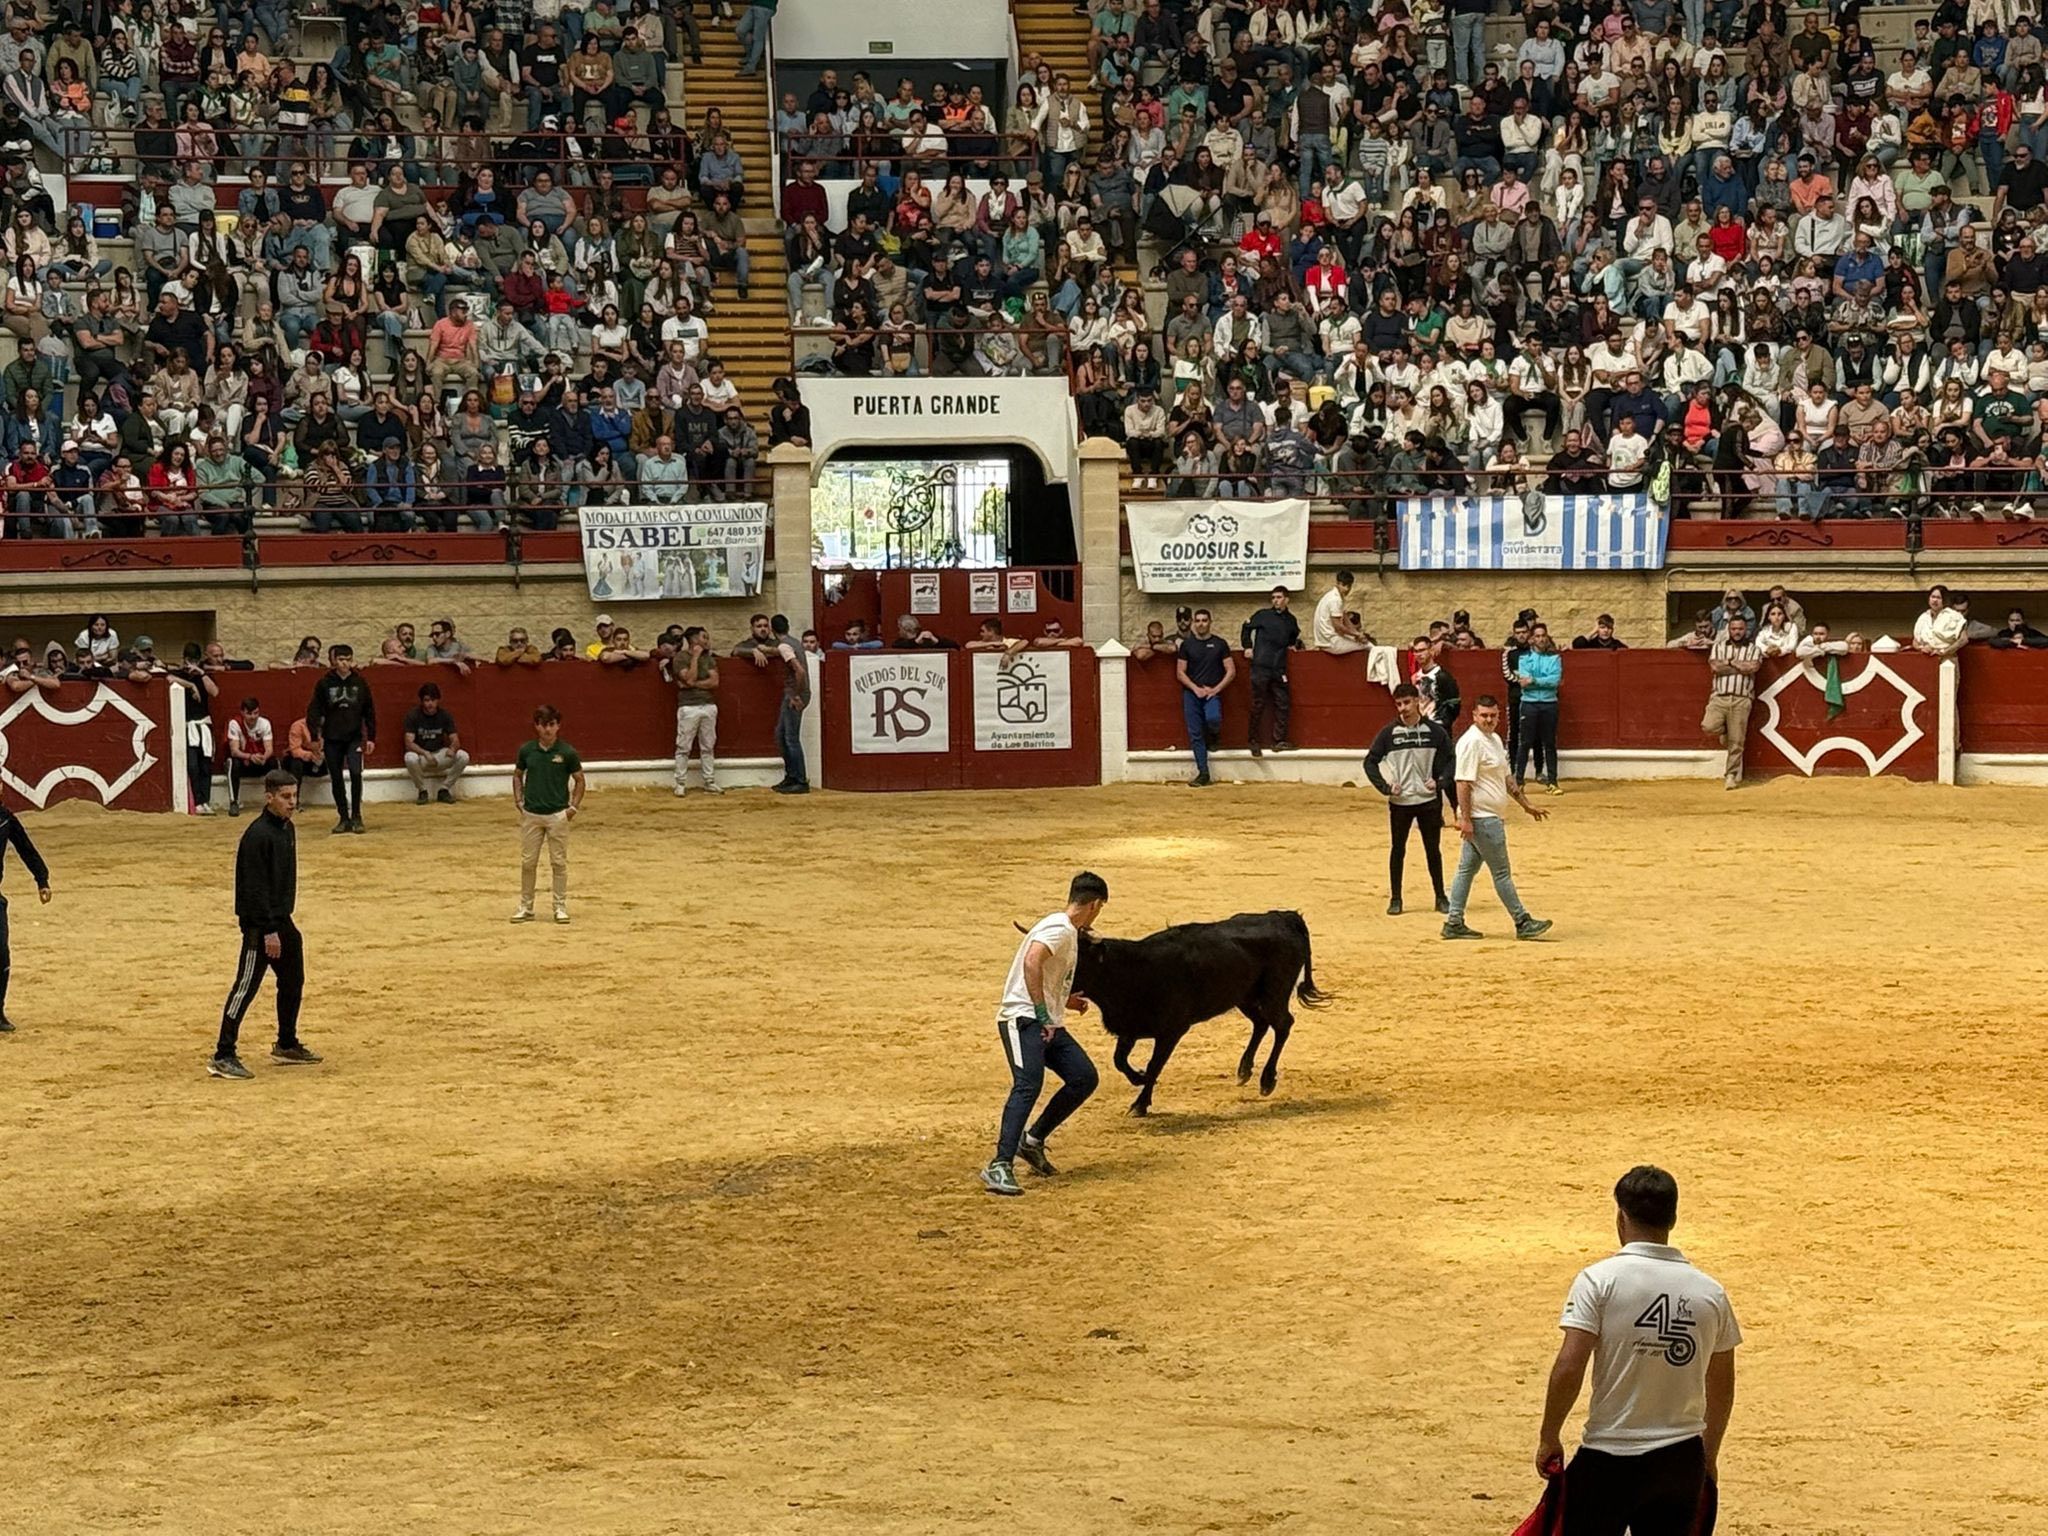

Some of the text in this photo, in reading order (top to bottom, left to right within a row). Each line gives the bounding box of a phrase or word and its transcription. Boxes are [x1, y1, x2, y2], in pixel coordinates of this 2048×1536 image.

[853, 395, 1000, 415] PUERTA GRANDE
[585, 505, 763, 524] MODA FLAMENCA Y COMUNIÓN
[586, 525, 702, 549] ISABEL
[707, 526, 763, 537] 647 480 395
[724, 536, 757, 545] Barrios
[1160, 540, 1268, 560] GODOSUR S.L
[854, 665, 946, 694] RUEDOS DEL SUR
[870, 686, 932, 743] RS
[990, 731, 1056, 741] Ayuntamiento
[990, 740, 1056, 749] de Los Barrios
